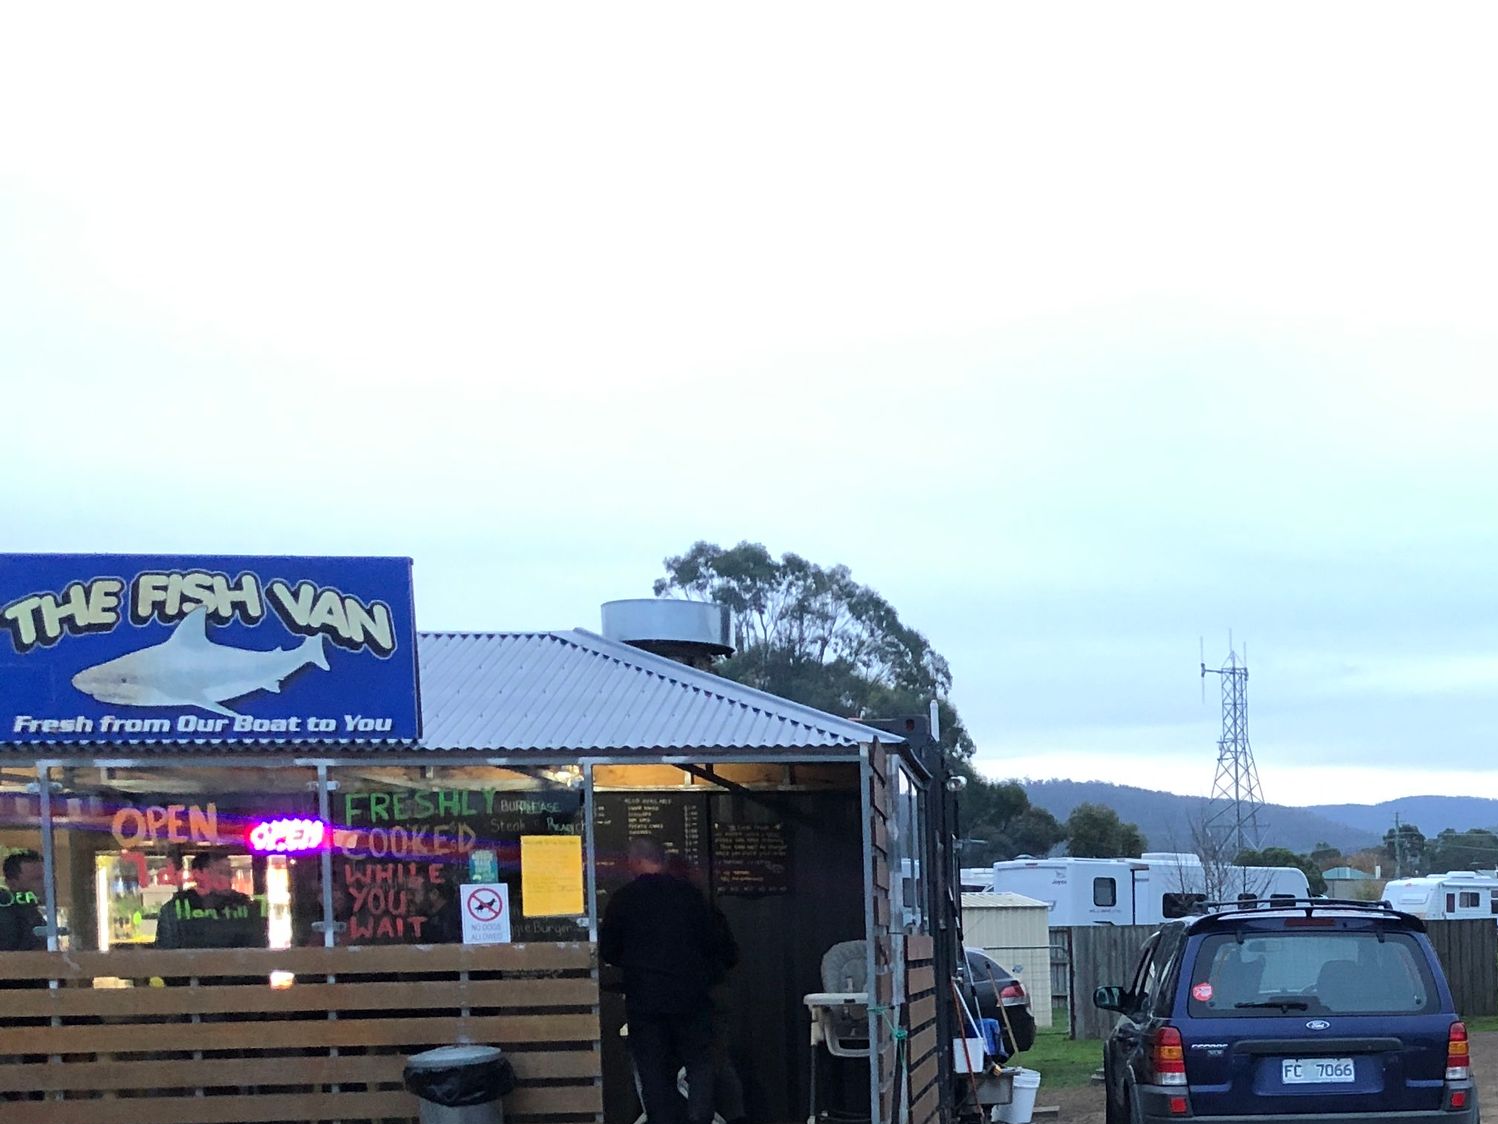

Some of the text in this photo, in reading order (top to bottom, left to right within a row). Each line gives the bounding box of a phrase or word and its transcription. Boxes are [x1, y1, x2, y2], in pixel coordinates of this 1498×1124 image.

[3, 570, 395, 656] THE FISH VAN
[13, 715, 392, 734] Fresh from Our Boat to You
[345, 787, 497, 826] FRESHLY
[111, 802, 218, 849] OPEN
[251, 818, 324, 851] OPEN
[341, 822, 477, 860] COOKED
[345, 863, 445, 885] WHILE
[348, 887, 408, 915] YOU
[350, 916, 428, 938] WAIT
[483, 923, 502, 931] DOGS
[1284, 1063, 1352, 1078] FC 7066
